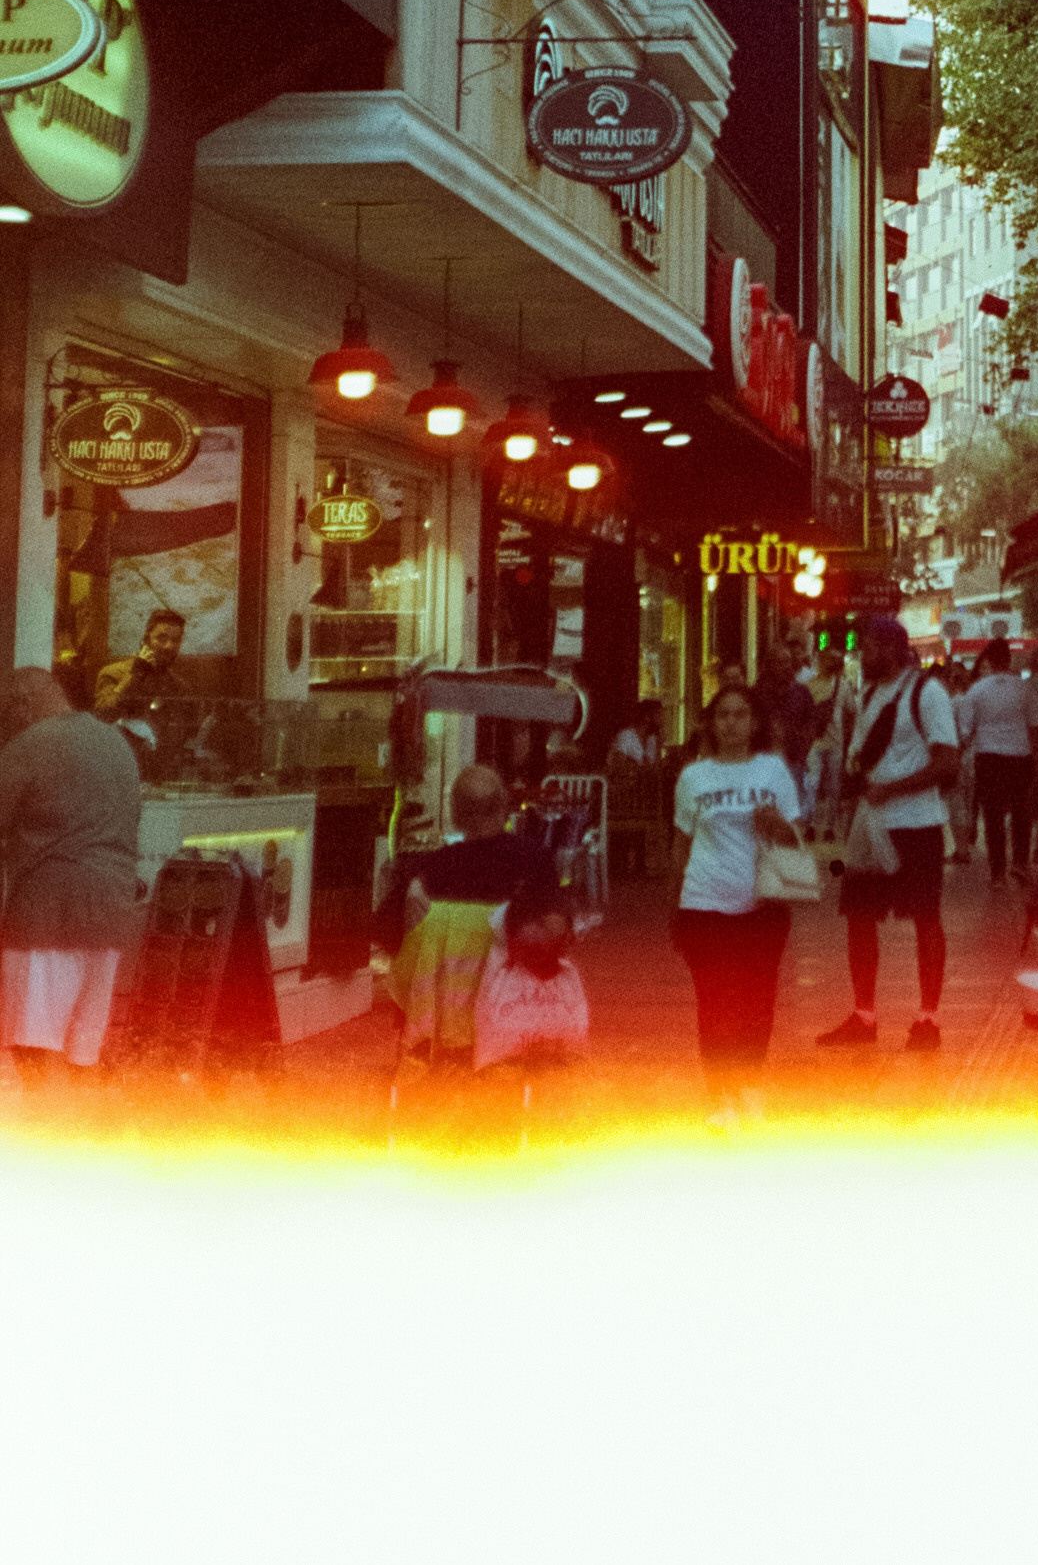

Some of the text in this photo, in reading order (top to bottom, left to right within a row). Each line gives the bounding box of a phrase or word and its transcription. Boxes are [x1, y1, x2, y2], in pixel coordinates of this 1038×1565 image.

[0, 37, 53, 55] um
[626, 128, 659, 146] USTA
[139, 440, 171, 460] USTA
[322, 500, 368, 524] TERAS
